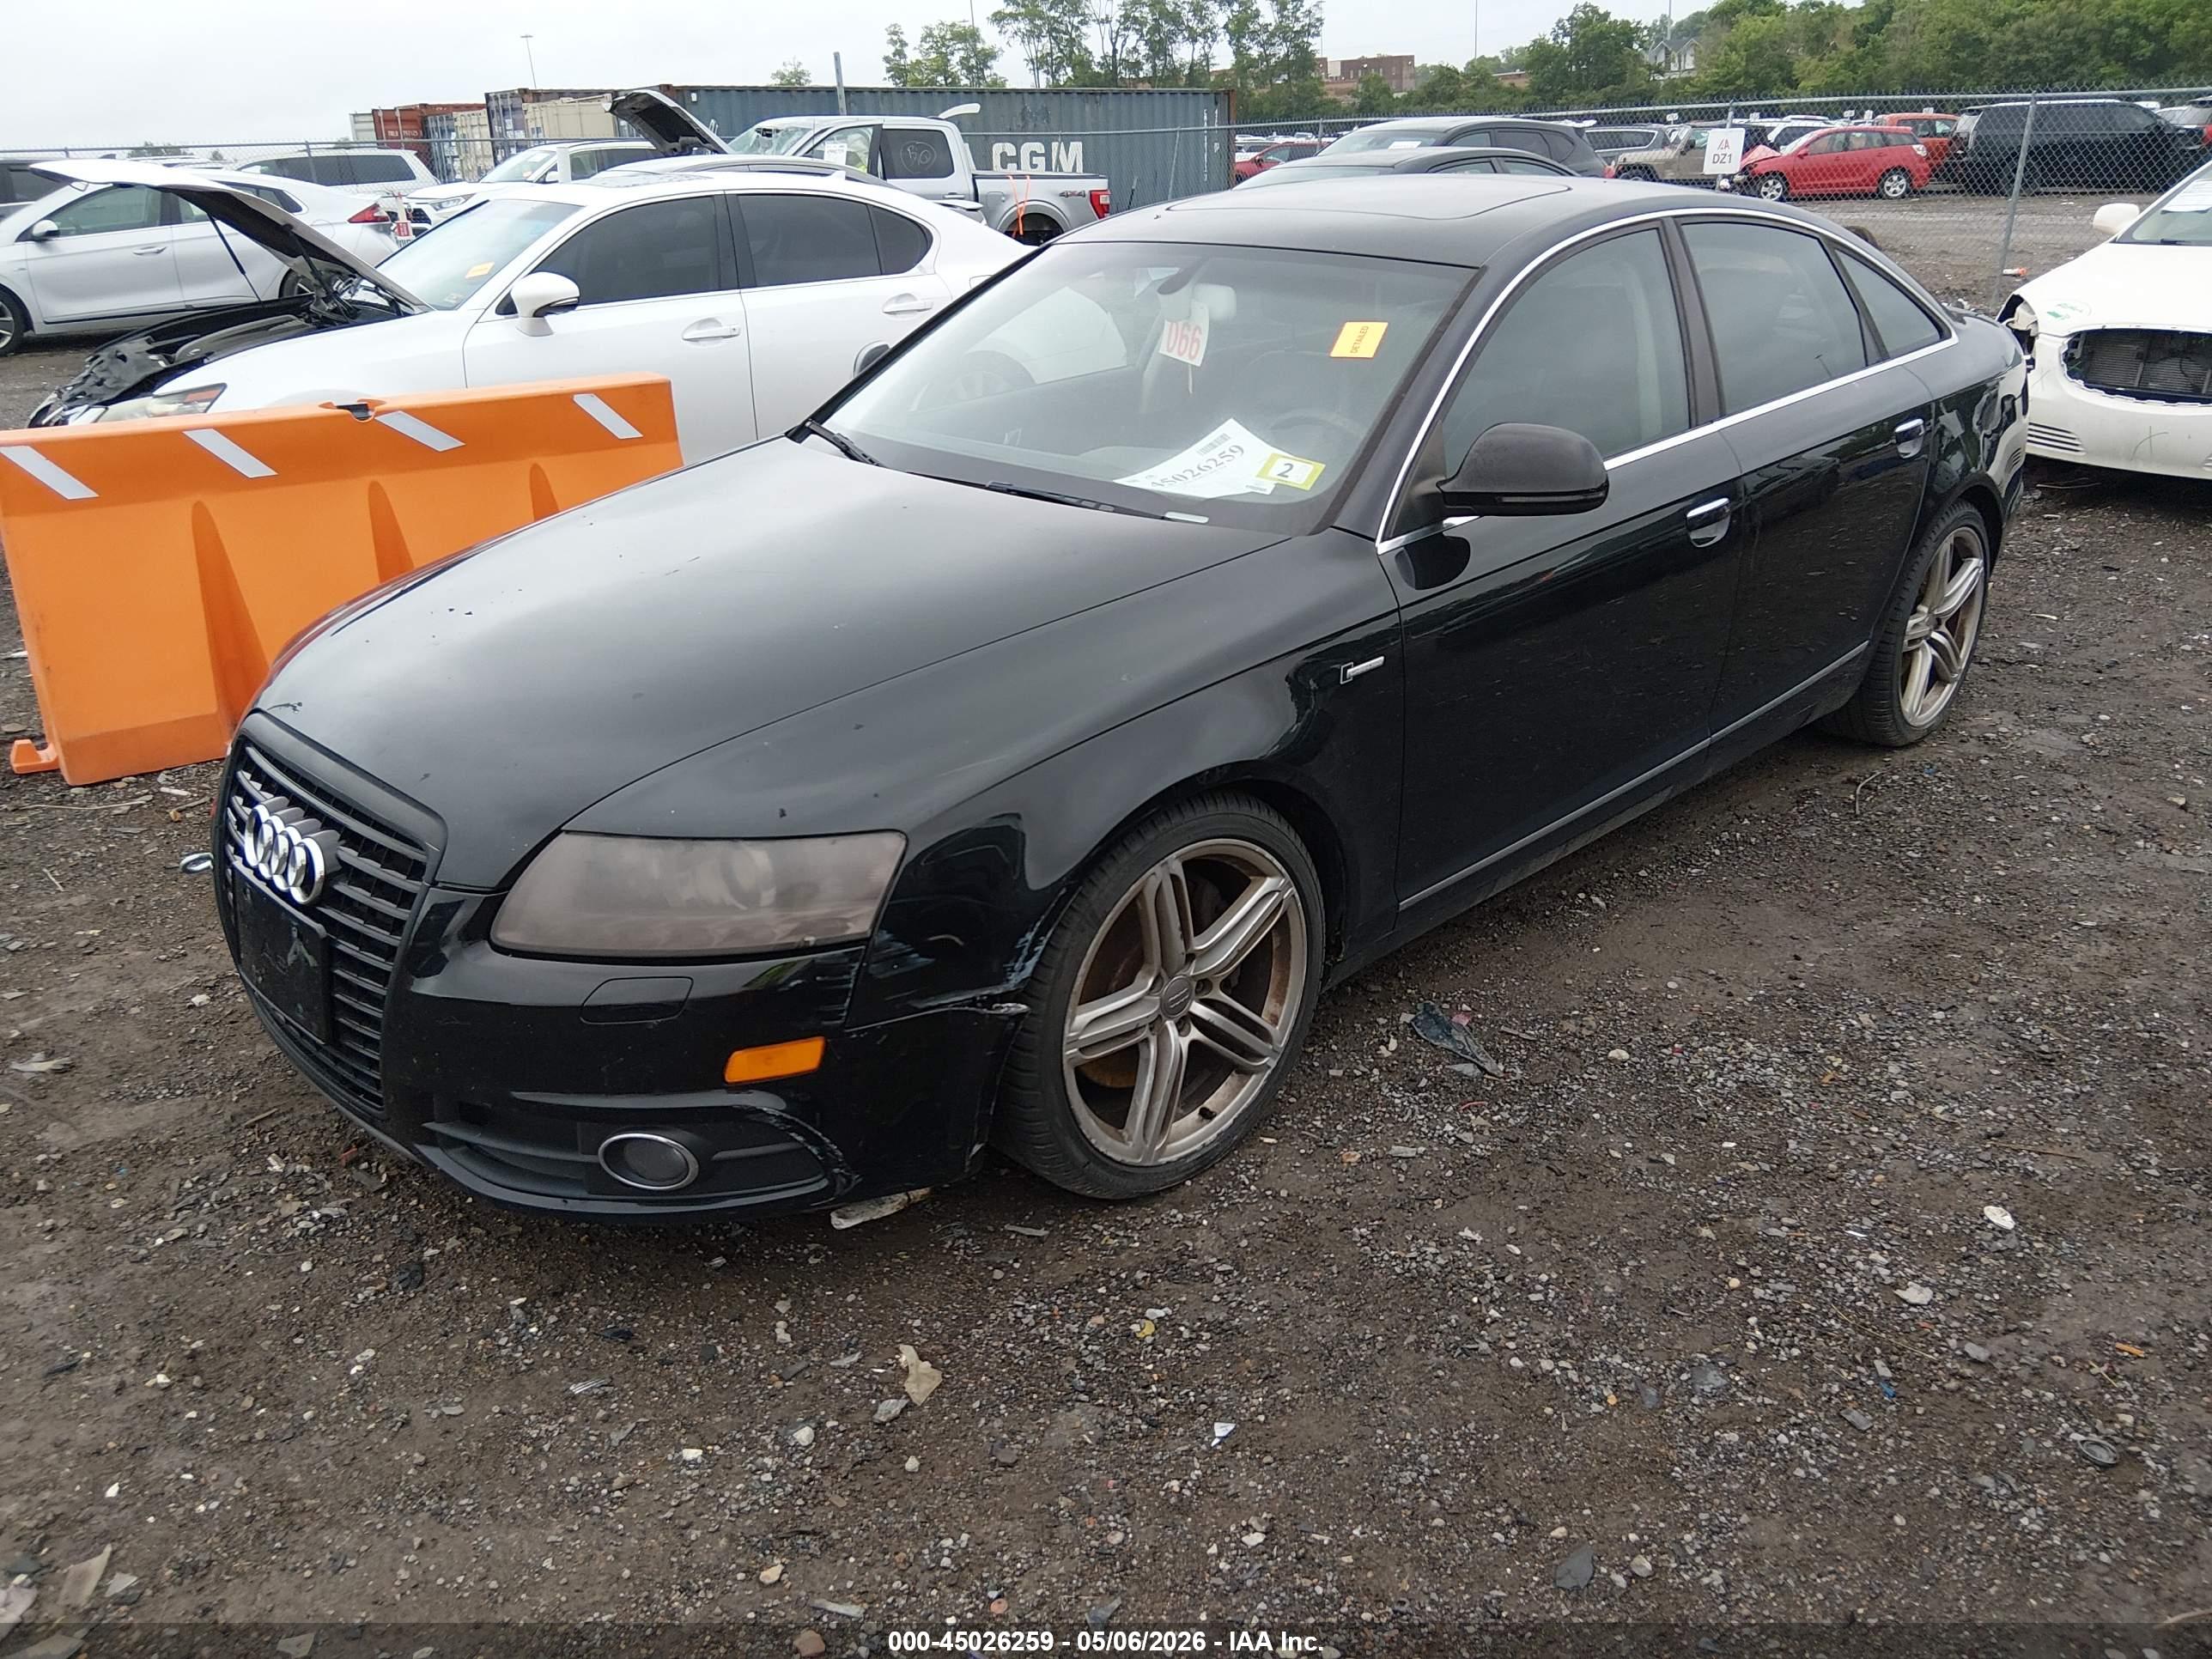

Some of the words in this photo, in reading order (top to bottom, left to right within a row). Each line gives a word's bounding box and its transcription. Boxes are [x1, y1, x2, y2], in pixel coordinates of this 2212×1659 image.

[992, 141, 1084, 173] CGM
[1712, 153, 1732, 164] DZ1
[1276, 462, 1295, 478] 2
